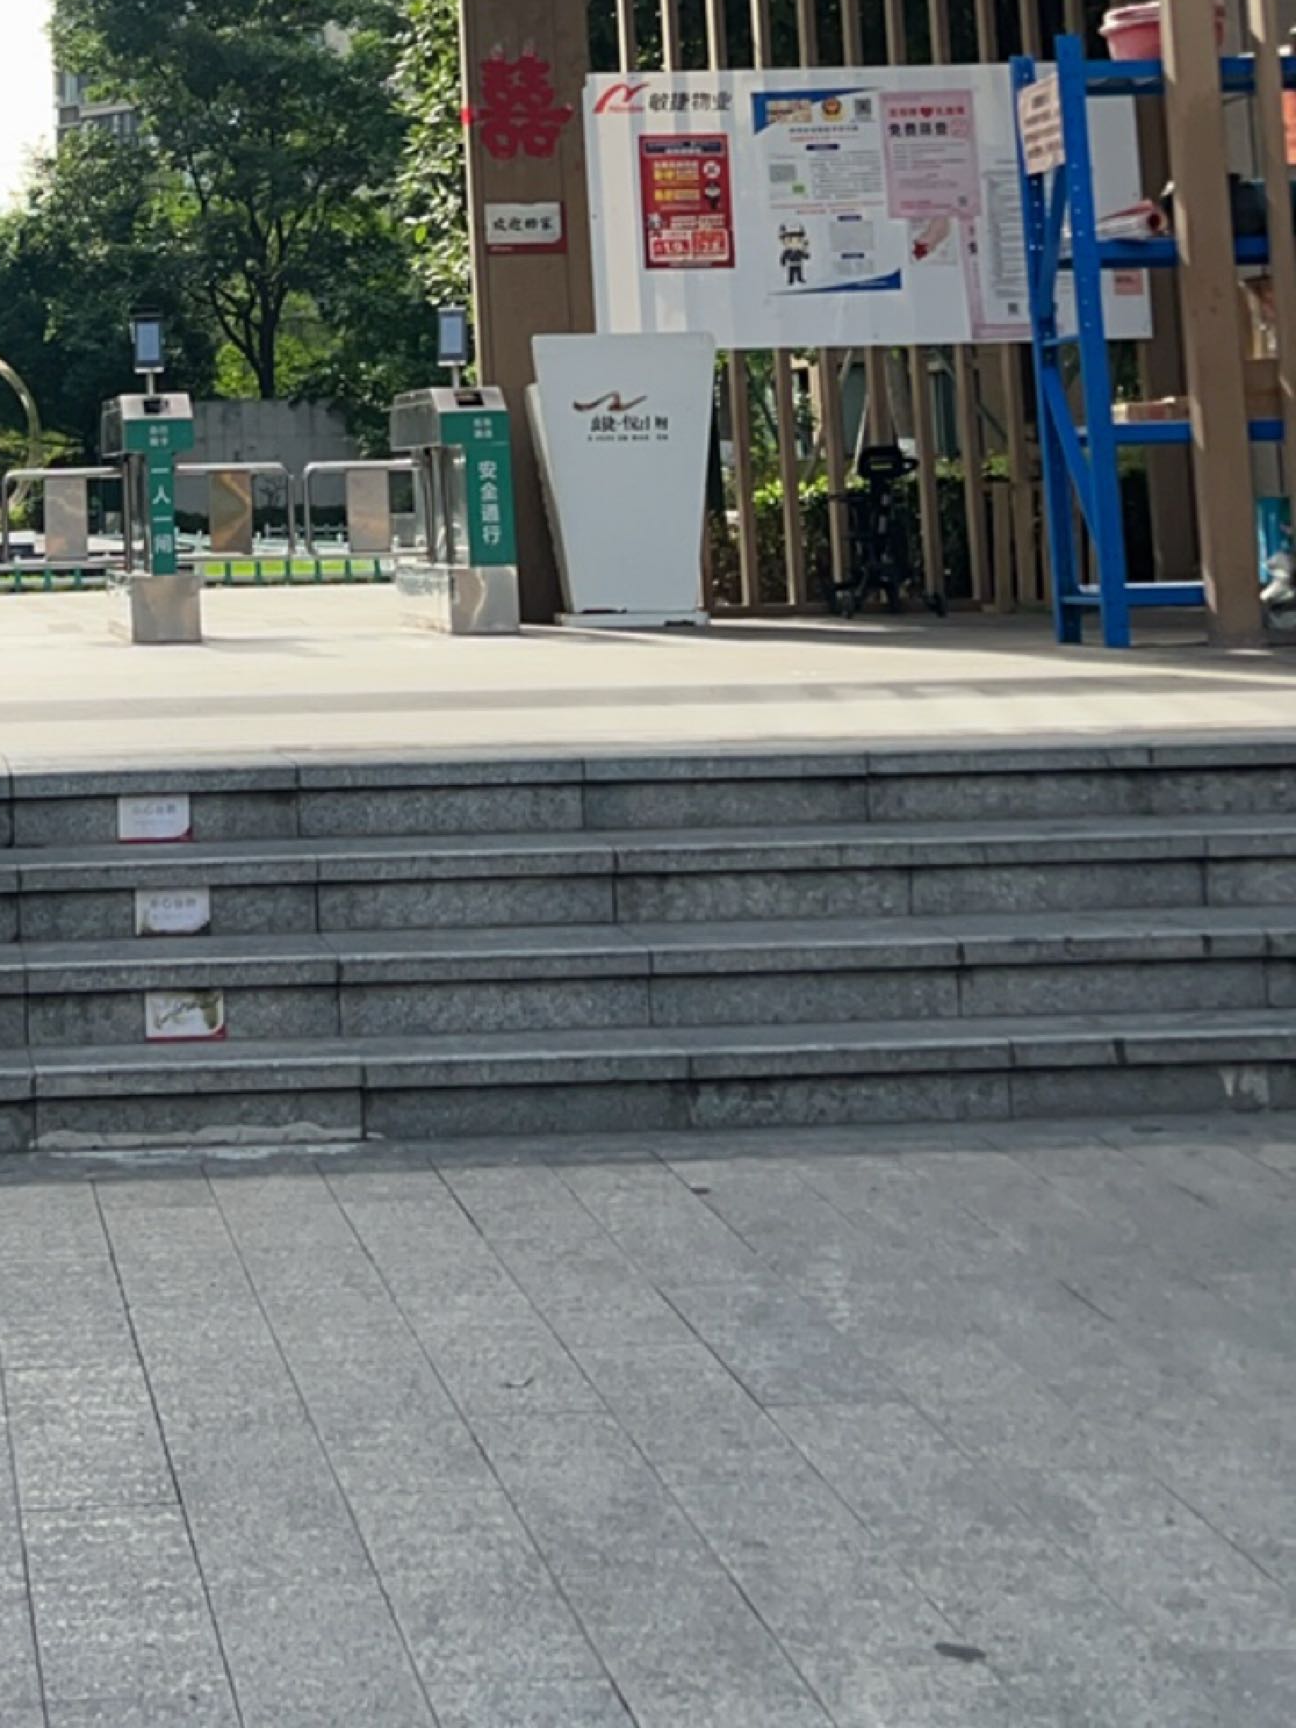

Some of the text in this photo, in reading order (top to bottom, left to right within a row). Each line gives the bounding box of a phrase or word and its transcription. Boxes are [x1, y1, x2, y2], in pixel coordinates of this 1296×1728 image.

[649, 91, 732, 112] 敏捷物业
[477, 460, 501, 545] 安全通行
